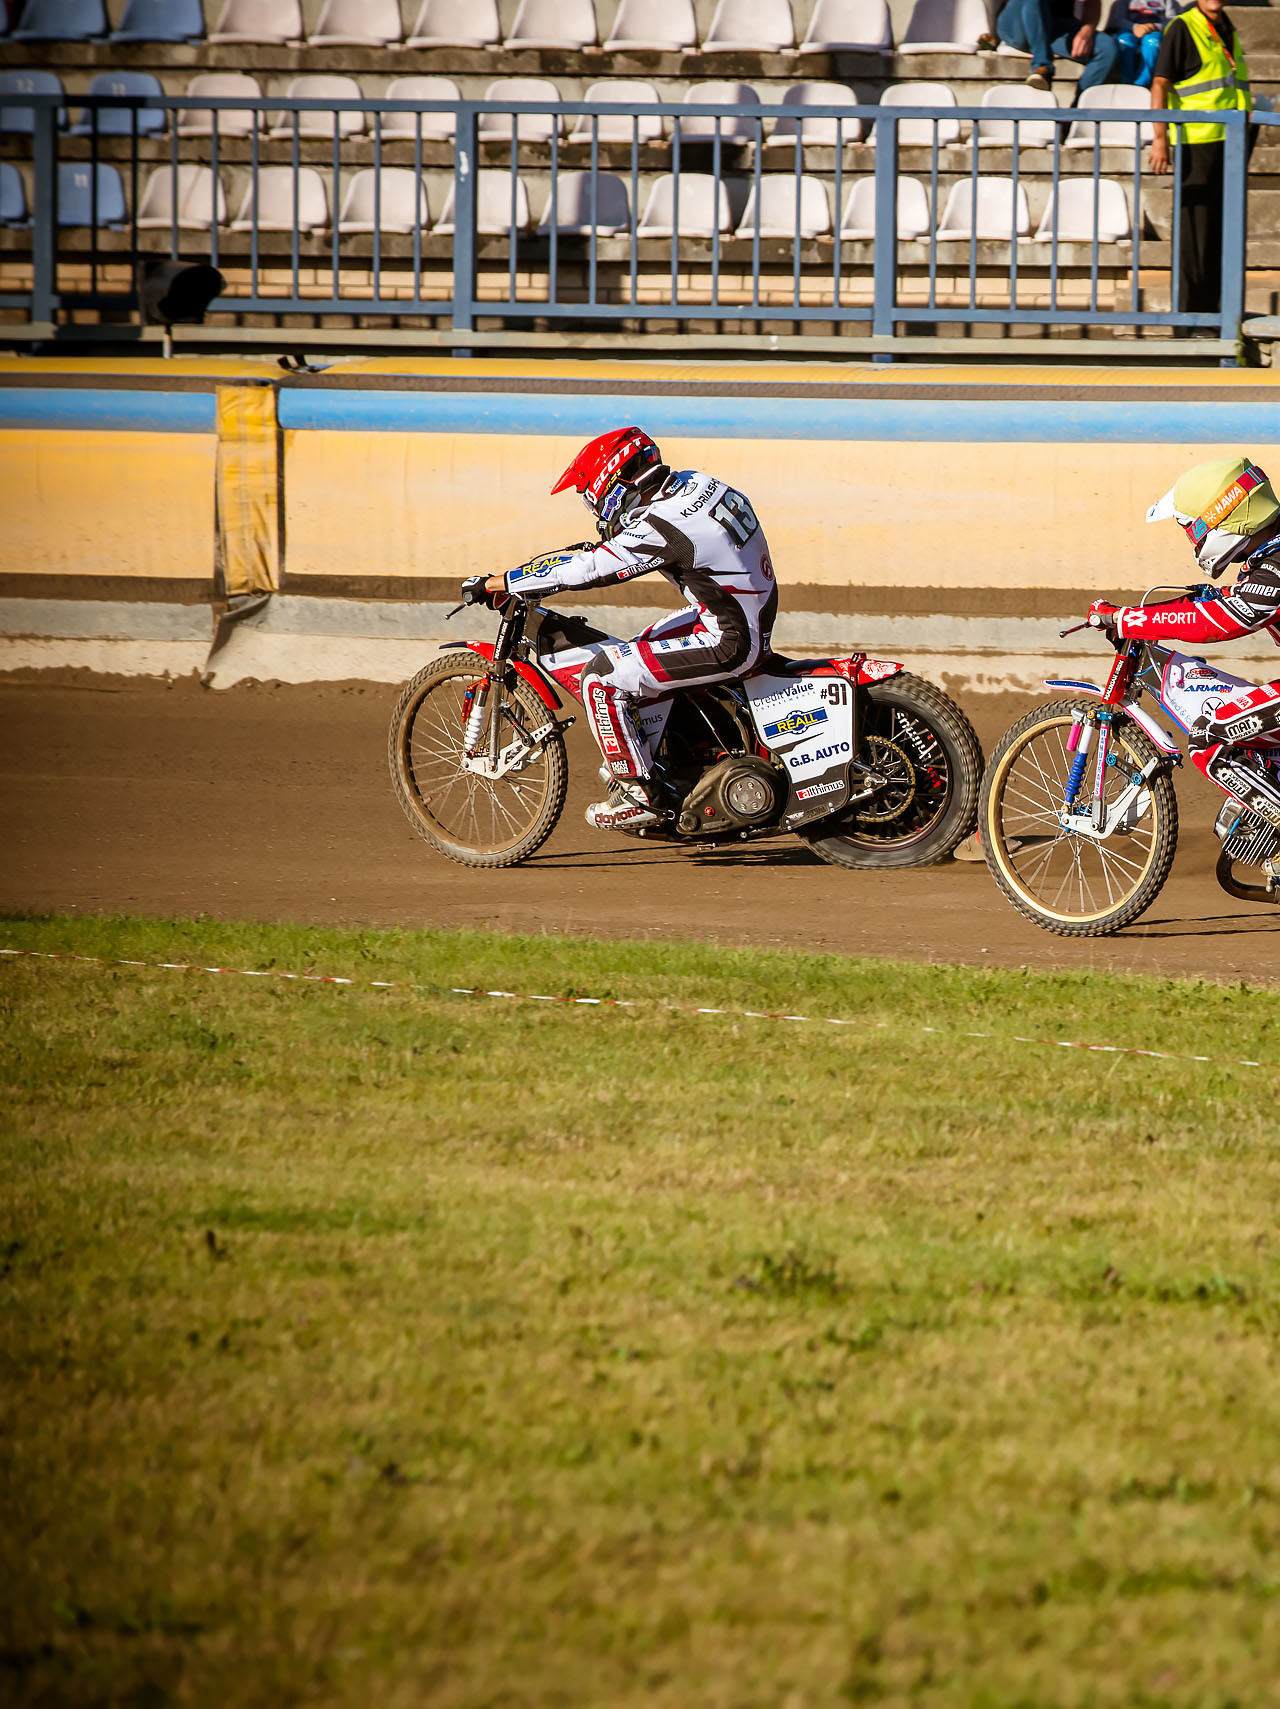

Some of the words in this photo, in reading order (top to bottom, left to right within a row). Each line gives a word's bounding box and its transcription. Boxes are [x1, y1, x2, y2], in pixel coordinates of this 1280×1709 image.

[593, 437, 642, 495] SCOTT
[1215, 484, 1243, 515] HAWA
[712, 490, 759, 544] 13
[523, 555, 563, 576] REALL
[1152, 612, 1196, 624] AFORTI
[820, 683, 848, 706] #91
[594, 687, 620, 753] althimus
[776, 712, 818, 733] REALL
[789, 752, 815, 768] G.B.
[816, 741, 850, 761] AUTO
[800, 779, 845, 799] althimus
[595, 806, 646, 826] daytona
